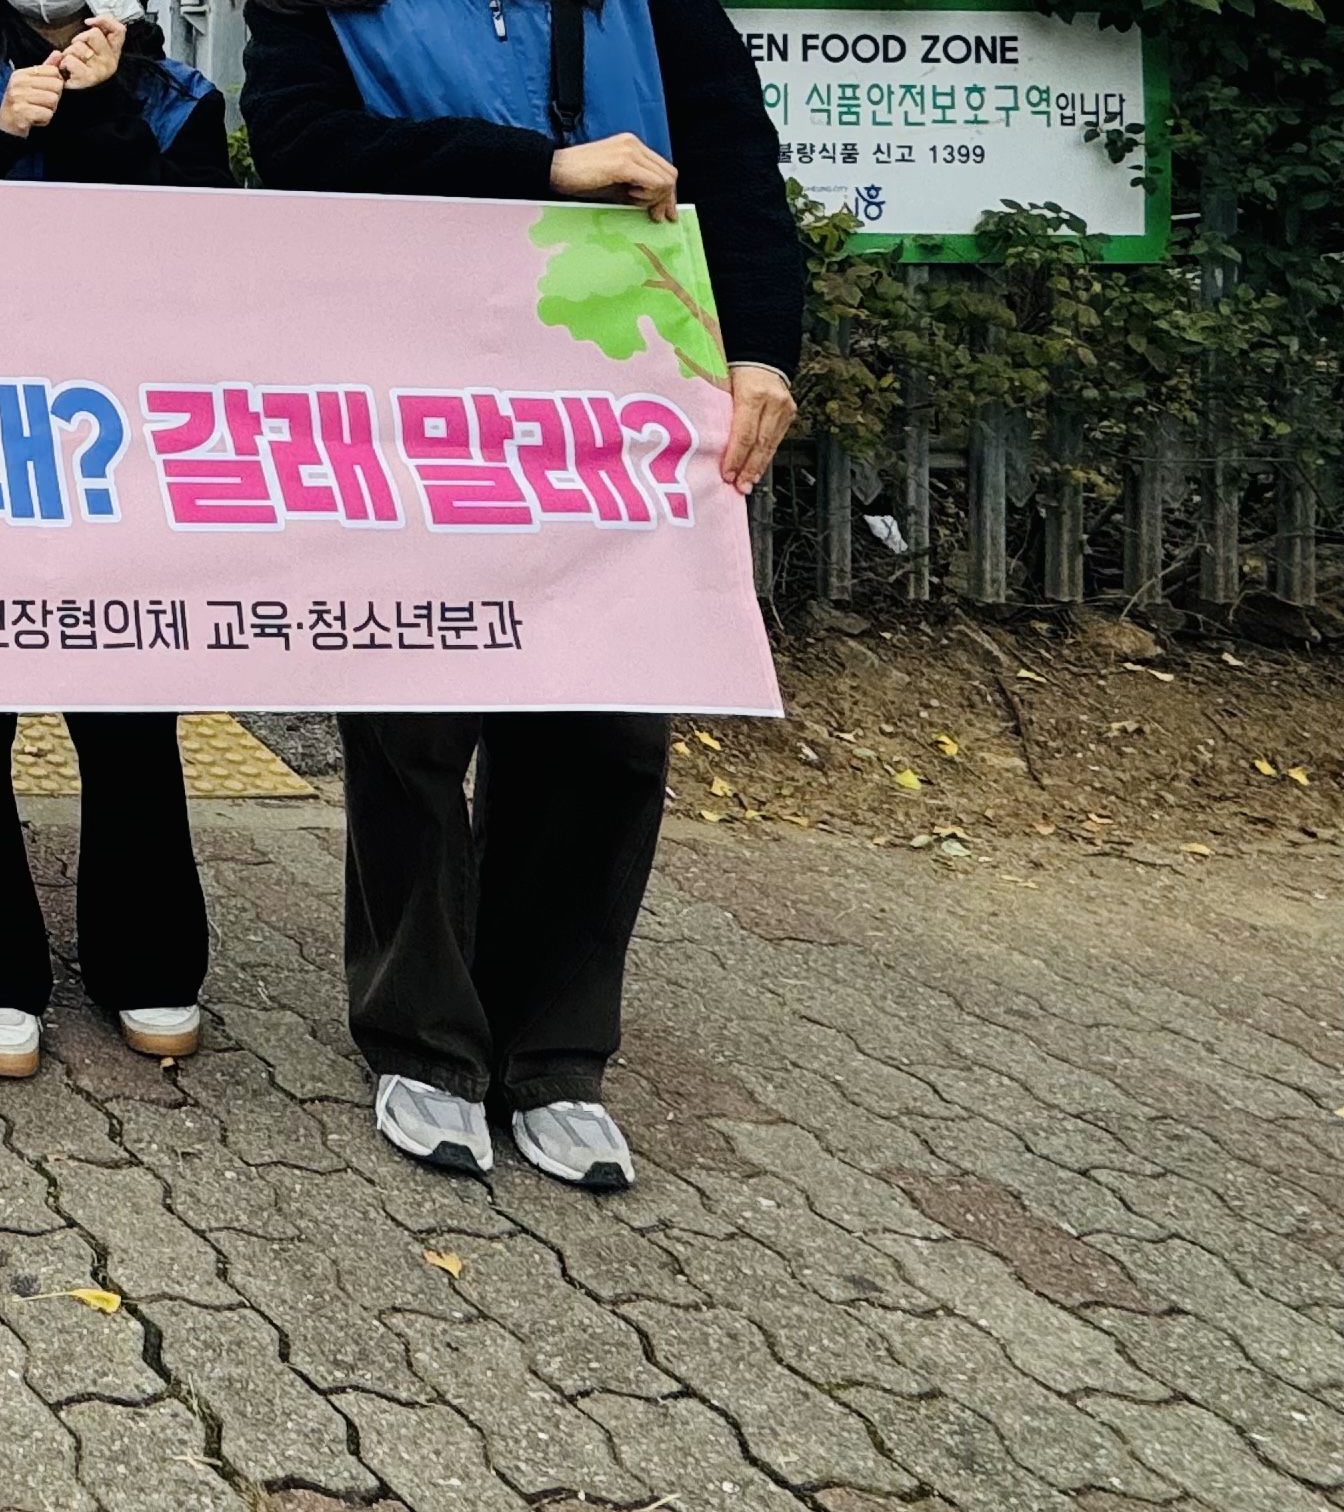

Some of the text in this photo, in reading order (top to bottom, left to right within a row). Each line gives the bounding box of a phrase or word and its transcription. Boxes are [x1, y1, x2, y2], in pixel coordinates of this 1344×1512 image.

[739, 33, 1020, 64] EN FOOD ZONE
[872, 143, 916, 164] 신고
[929, 144, 985, 164] 1399
[144, 388, 400, 524] 갈래
[396, 394, 698, 525] 말래?
